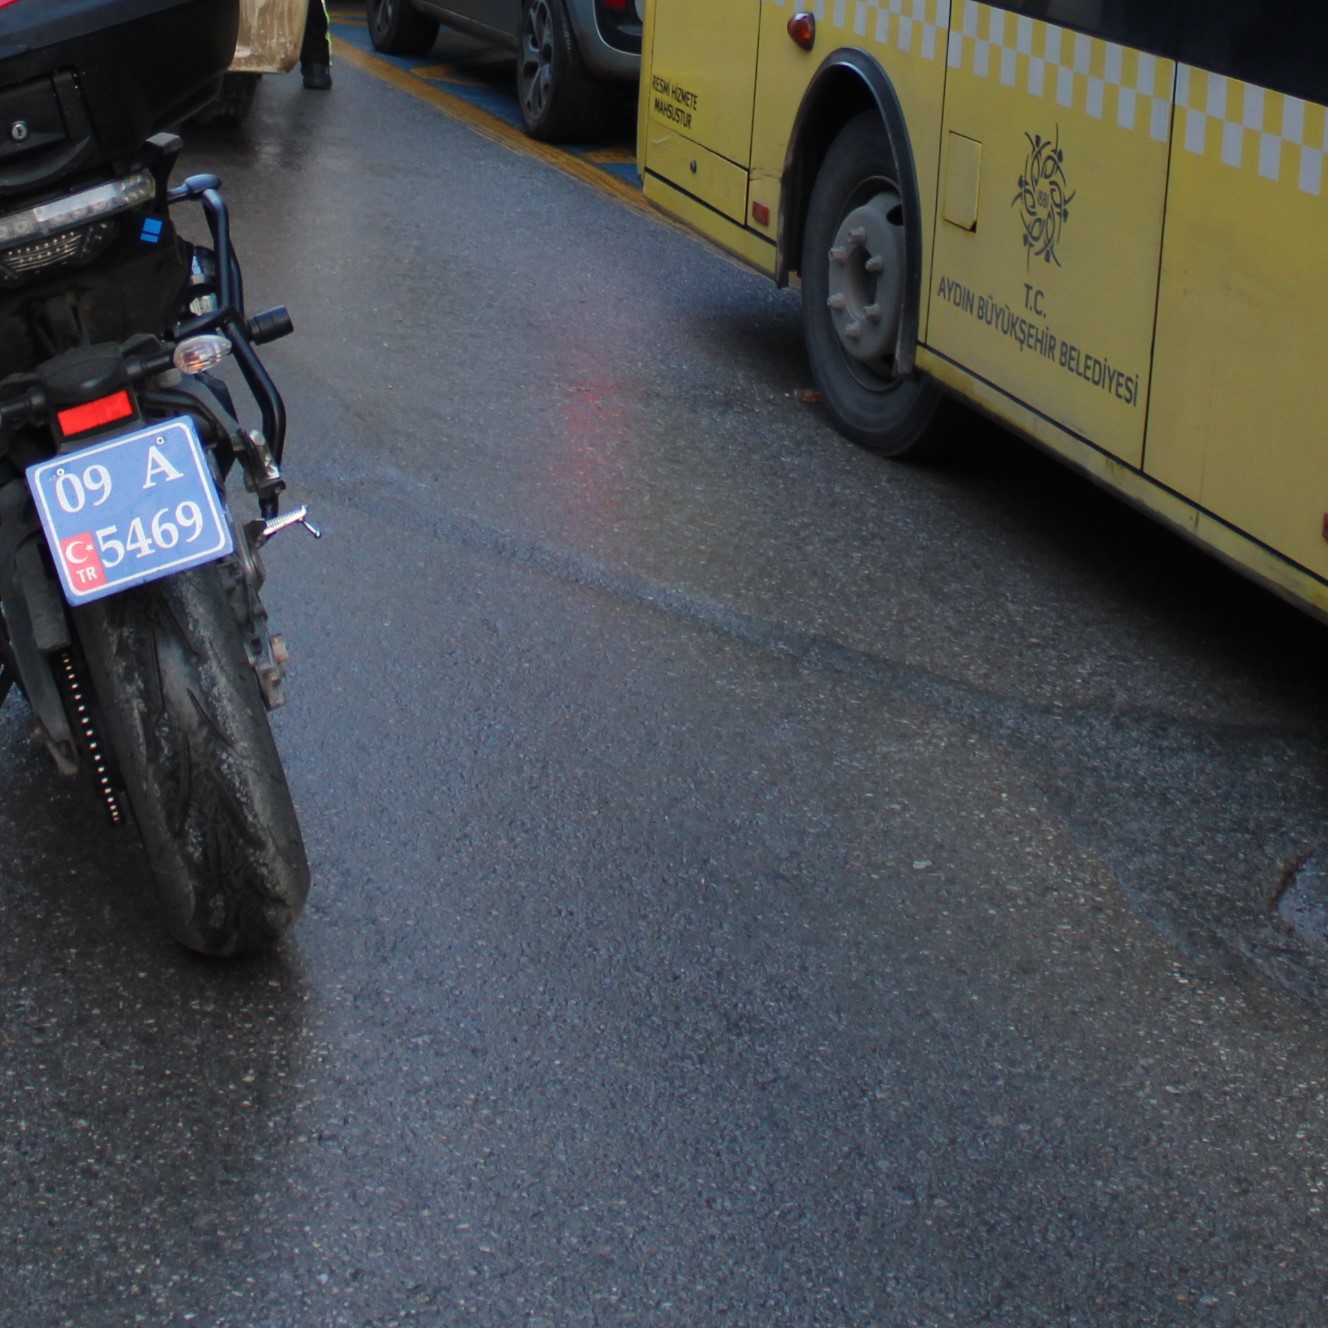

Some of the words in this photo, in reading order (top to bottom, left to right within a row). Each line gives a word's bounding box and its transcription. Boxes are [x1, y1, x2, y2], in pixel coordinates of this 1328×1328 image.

[655, 97, 692, 129] MAHSUSTUR
[671, 83, 698, 111] HİZMETE
[1023, 283, 1047, 318] T.C.
[937, 276, 975, 315] AYDIN
[977, 294, 1057, 362] BÜYÜKŞEHİR
[1059, 340, 1139, 407] BELEDİYESİ
[55, 463, 112, 514] 09
[142, 445, 184, 490] A
[95, 500, 204, 569] 5469
[75, 566, 98, 586] TR
